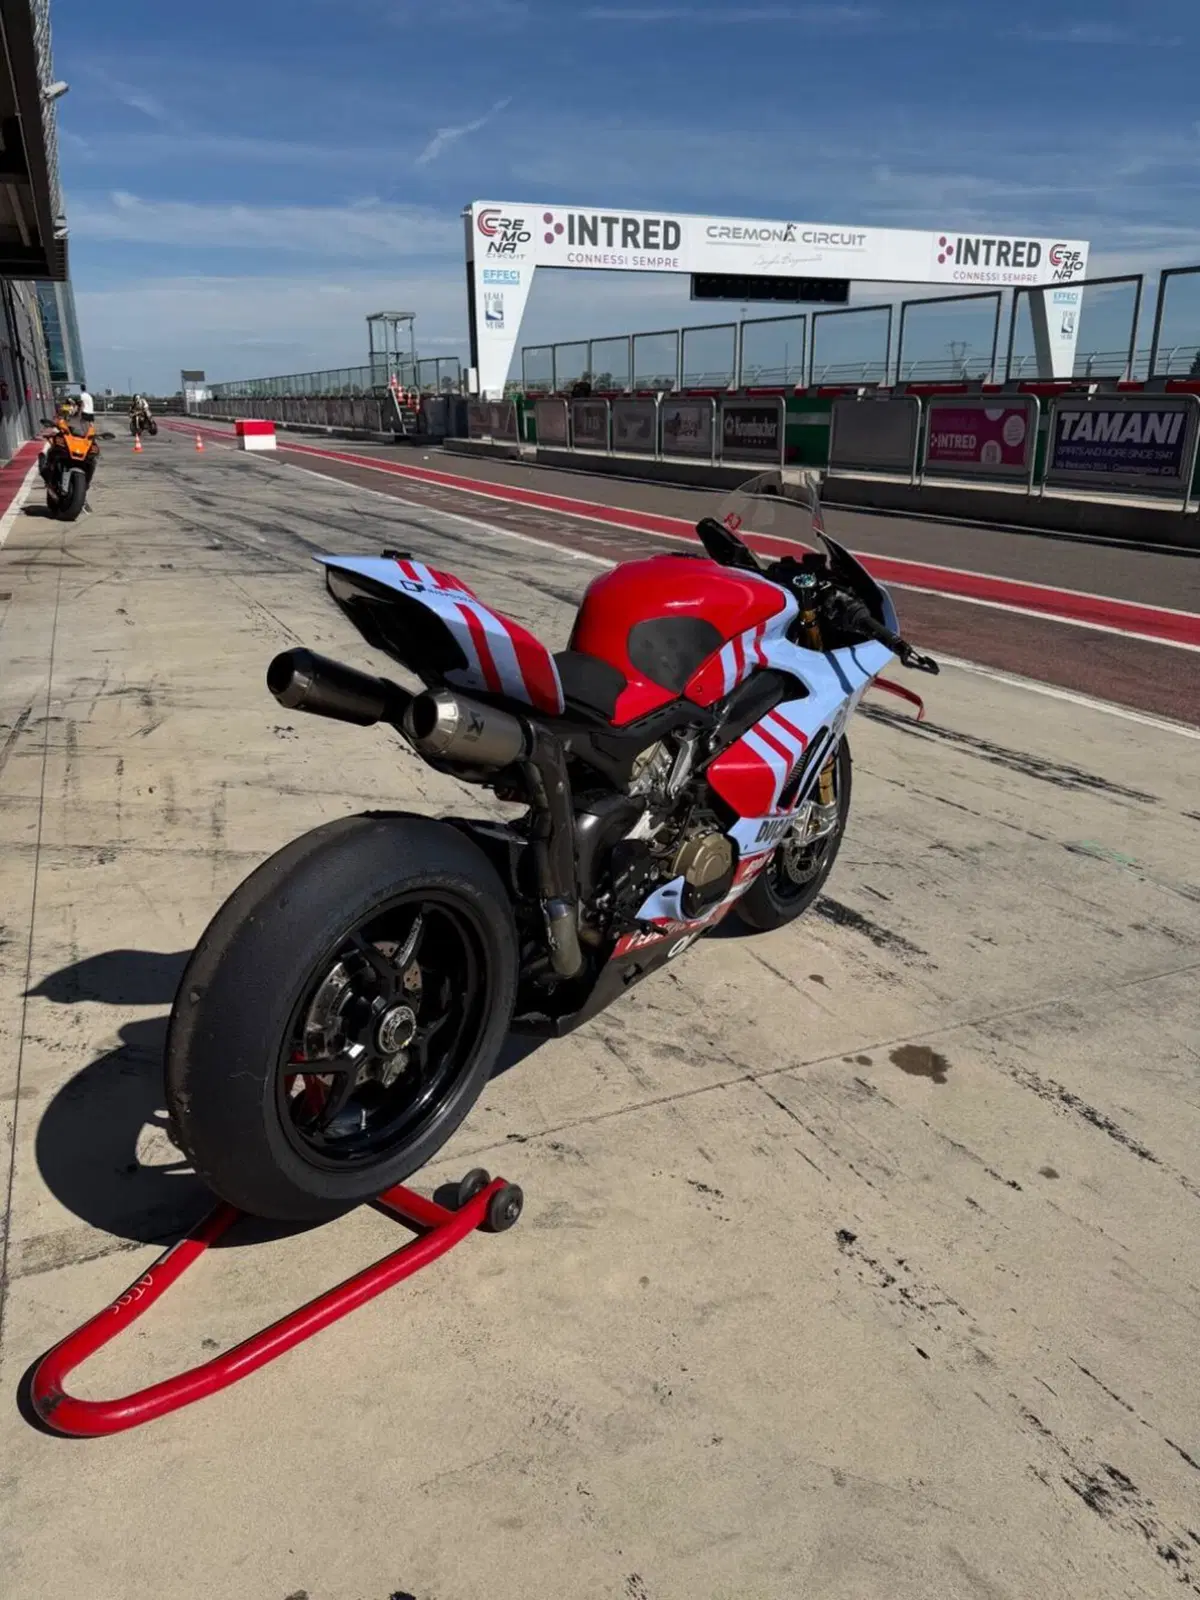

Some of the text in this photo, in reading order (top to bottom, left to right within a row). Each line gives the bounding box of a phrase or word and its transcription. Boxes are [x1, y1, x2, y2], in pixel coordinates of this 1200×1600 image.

[567, 213, 681, 251] INTRED
[706, 225, 867, 246] CREMONA CIRCUIT
[567, 252, 680, 268] CONNESSI SEMPRE
[954, 237, 1042, 268] INTRED
[482, 269, 520, 280] EFFECI
[952, 270, 1038, 283] CONNESSI SEMPRE
[1059, 411, 1185, 445] TAMANI
[937, 432, 977, 450] INTRED
